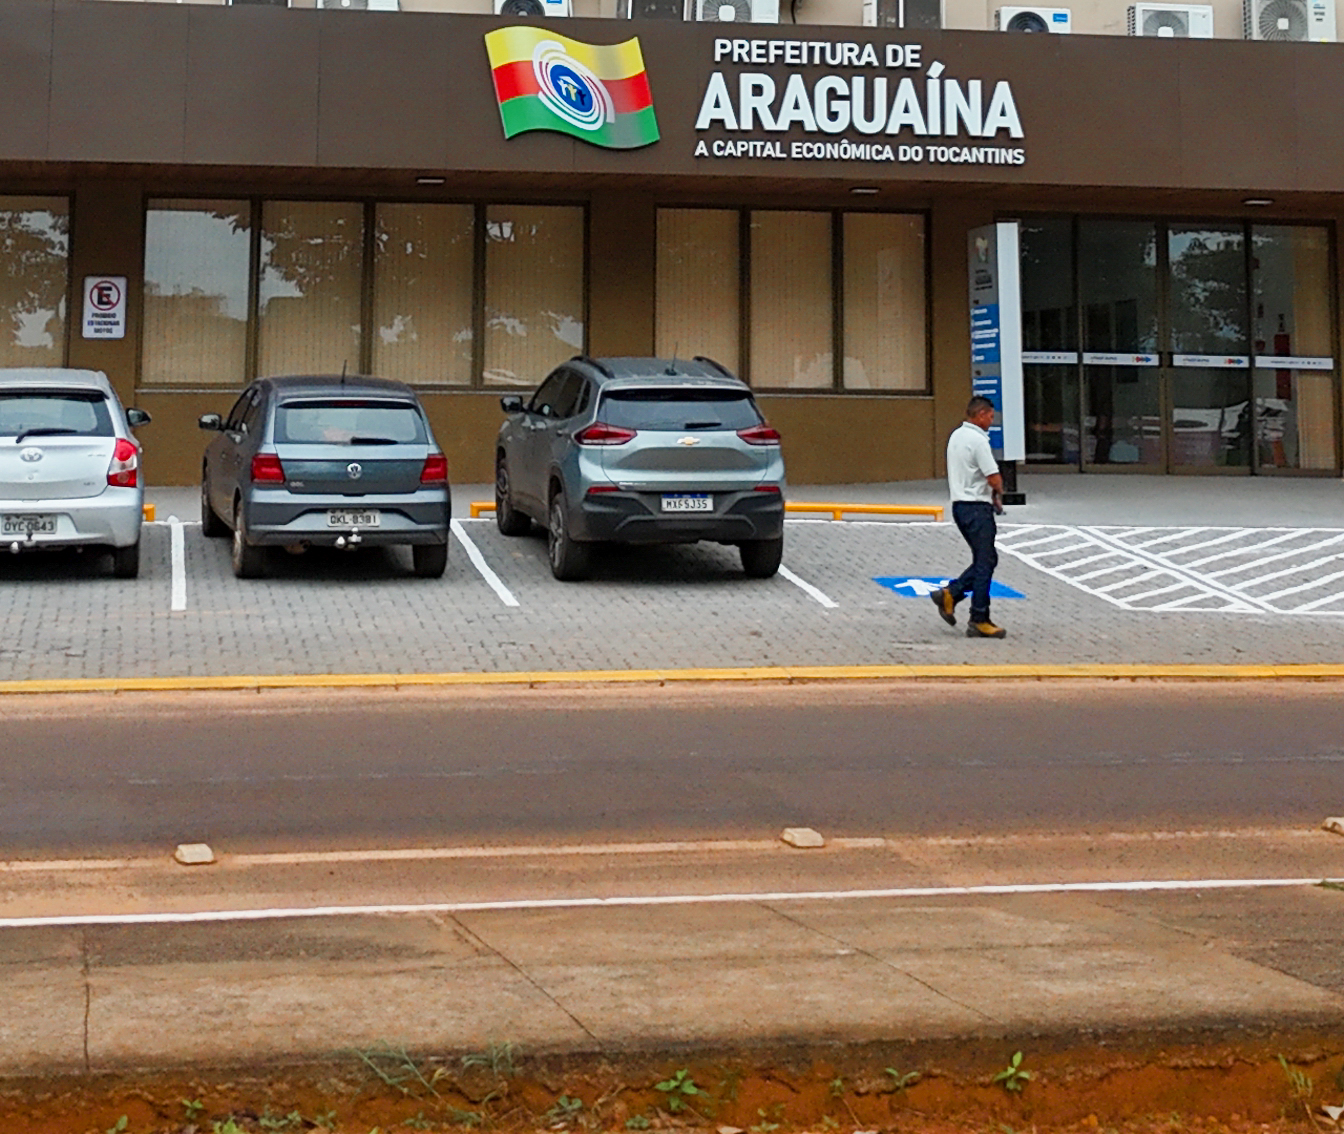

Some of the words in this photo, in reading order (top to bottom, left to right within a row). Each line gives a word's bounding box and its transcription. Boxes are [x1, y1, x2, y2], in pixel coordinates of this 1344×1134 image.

[714, 38, 880, 66] PREFEITURA
[885, 43, 922, 68] DE
[694, 60, 1025, 139] ARAGUAÍNA
[694, 140, 710, 157] A
[712, 140, 787, 159] CAPITAL
[791, 138, 895, 162] ECONÔMICA
[898, 145, 924, 162] DO
[926, 146, 1025, 165] TOCANTINS
